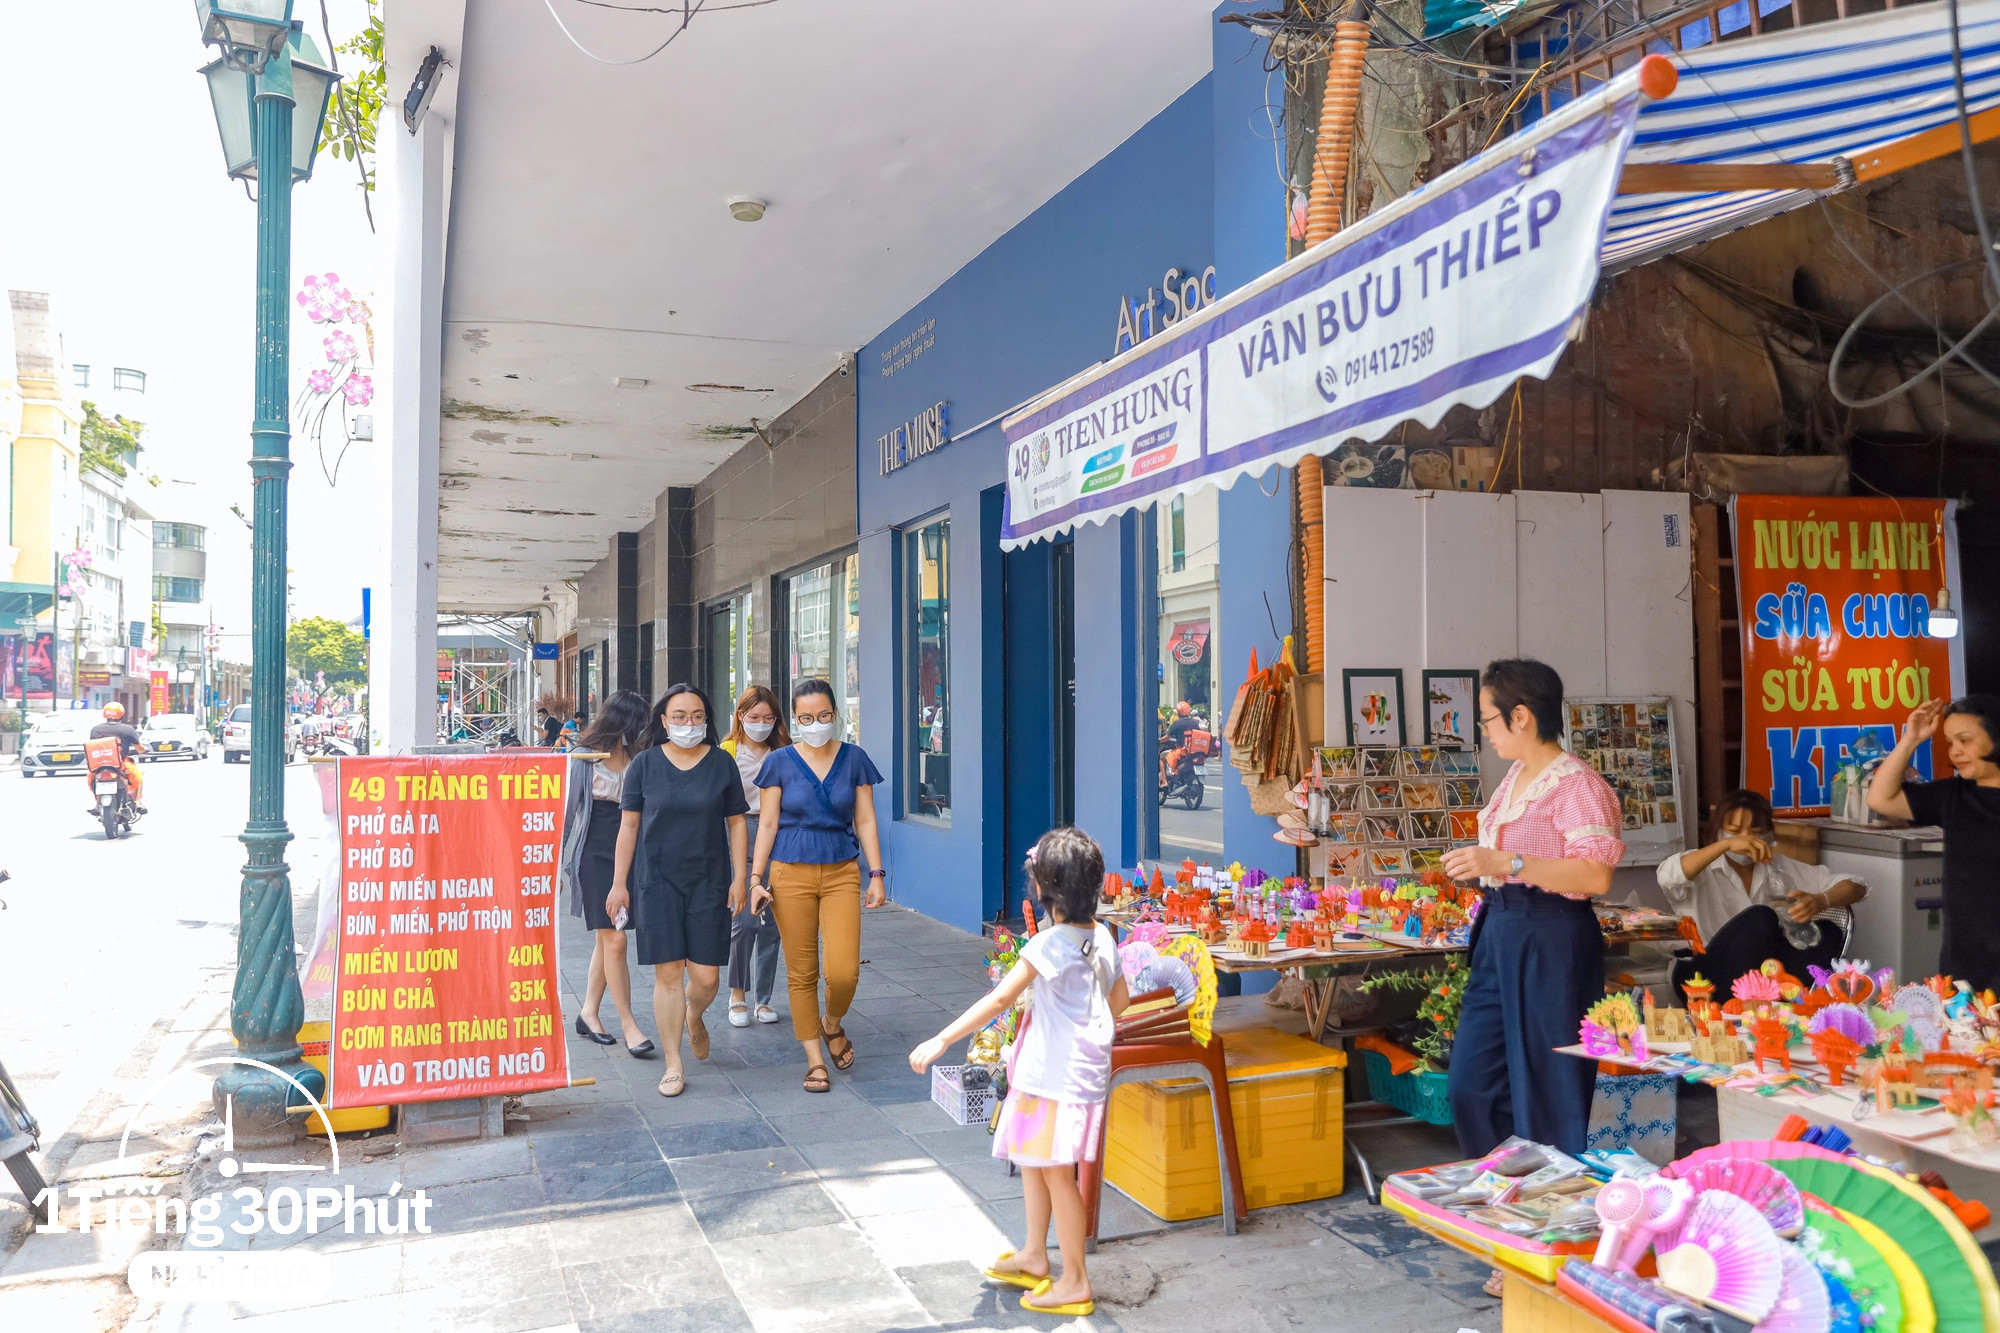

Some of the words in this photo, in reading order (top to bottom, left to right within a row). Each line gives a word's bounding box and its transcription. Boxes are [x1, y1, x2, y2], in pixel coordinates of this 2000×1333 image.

[1237, 313, 1307, 379] VÂN
[1316, 267, 1401, 347] BƯU
[1414, 183, 1562, 300] THIẾP
[1113, 287, 1157, 356] Art
[1343, 326, 1435, 388] 0914127589
[877, 426, 902, 476] THE
[904, 401, 945, 463] MUSE
[1014, 443, 1030, 484] 49
[1753, 510, 1841, 570] NƯỚC
[1850, 520, 1931, 580] LẠNH
[1754, 582, 1832, 640] SỮA
[1842, 592, 1932, 640] CHUA
[1761, 656, 1840, 713] SỮA
[1846, 658, 1931, 711] TƯƠI
[347, 776, 387, 802] 49
[394, 767, 489, 802] TRÀNG
[498, 764, 561, 801] TIỀN
[347, 806, 386, 836] PHỞ
[390, 811, 414, 835] GÀ
[420, 813, 439, 835] TA
[522, 812, 555, 833] 35K
[347, 839, 384, 869] PHỞ
[389, 842, 414, 868] BÒ
[522, 844, 554, 865] 35K
[347, 877, 384, 903] BÚN
[389, 873, 436, 901] MIẾN
[442, 877, 494, 899] NGAN
[521, 875, 552, 897] 35K
[1922, 876, 1944, 886] ALAS
[390, 906, 434, 936] MIẾN,
[438, 903, 470, 933] PHỞ
[473, 908, 512, 935] TRỘN
[525, 906, 550, 929] 35K
[344, 943, 398, 975] MIẾN
[405, 947, 458, 973] LƯƠN
[508, 943, 545, 967] 40K
[342, 984, 387, 1013] BÚN
[393, 979, 435, 1011] CHẢ
[509, 979, 547, 1004] 35K
[341, 1024, 385, 1051] CƠM
[391, 1022, 442, 1048] RANG
[448, 1015, 508, 1043] TRÀNG
[513, 1007, 553, 1039] TIỀN
[357, 1058, 406, 1088] VÀO
[412, 1054, 491, 1084] TRONG
[498, 1047, 547, 1076] NGÕ
